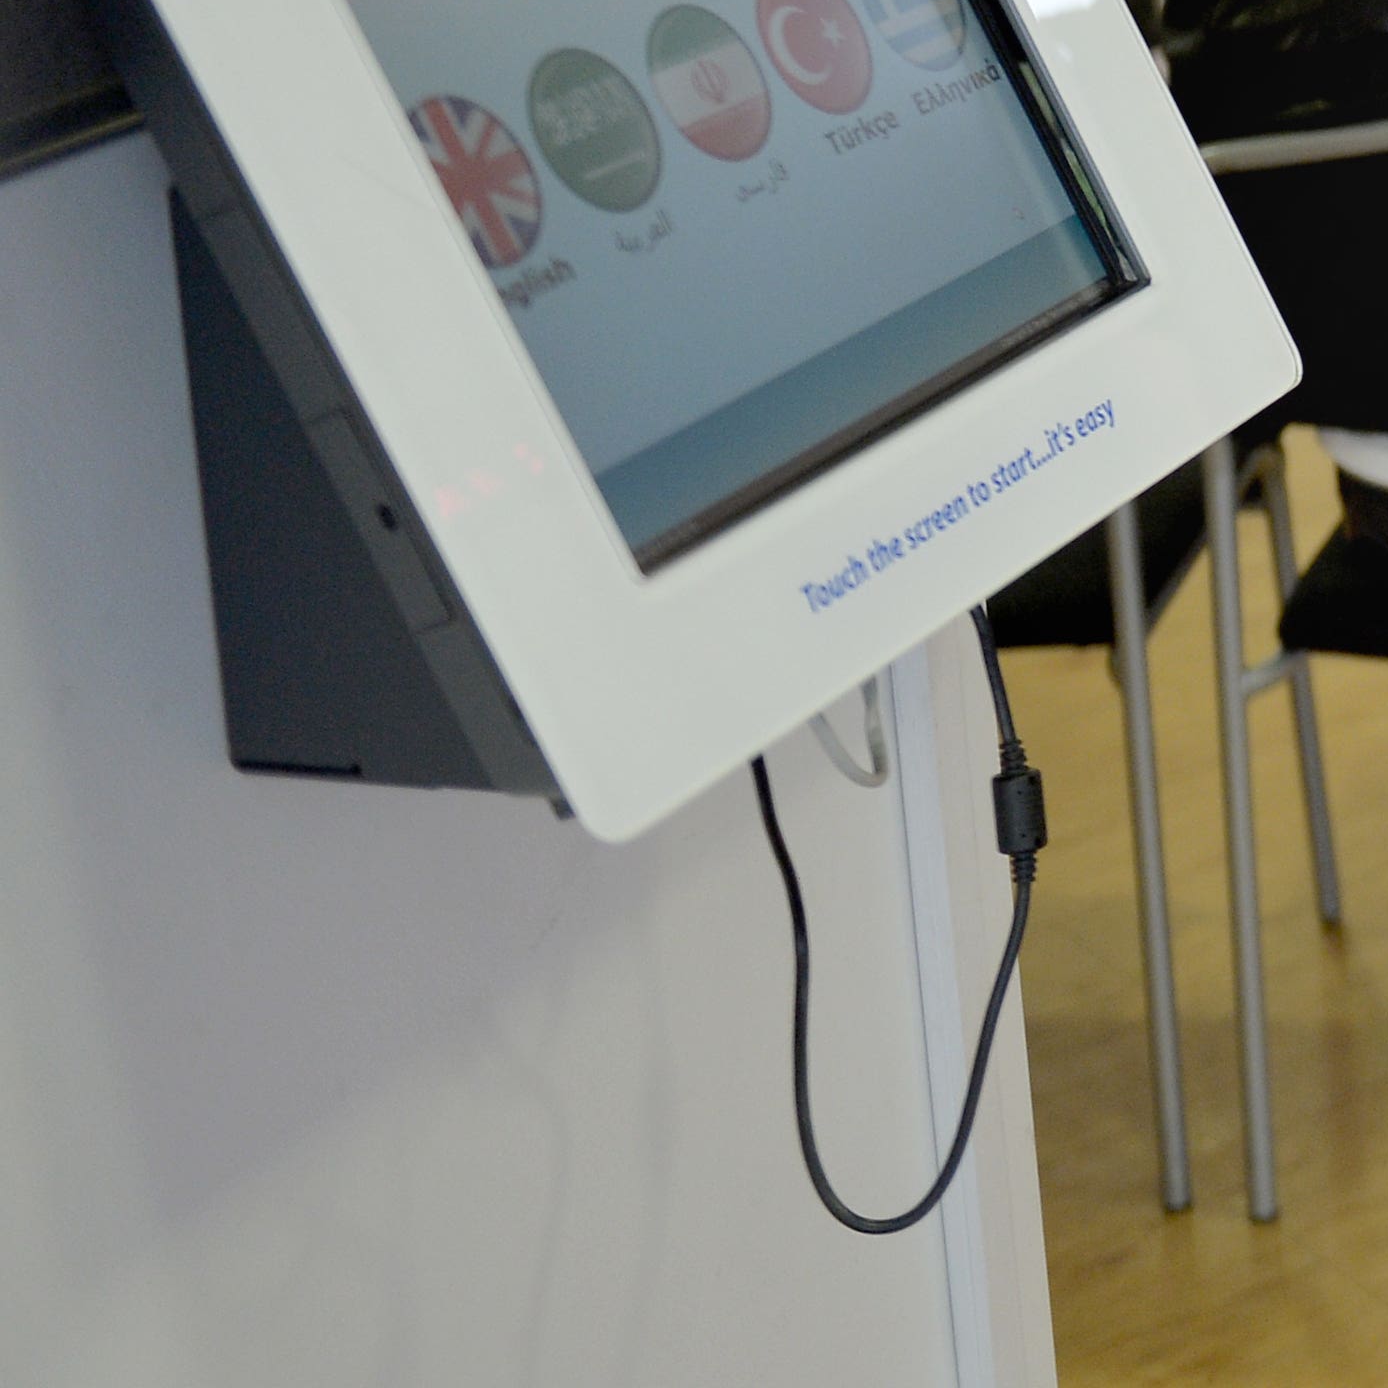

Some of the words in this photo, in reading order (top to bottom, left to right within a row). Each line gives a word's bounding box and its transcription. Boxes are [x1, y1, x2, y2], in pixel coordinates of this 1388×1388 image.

[822, 108, 901, 157] Türkçe
[497, 255, 578, 308] nglish
[801, 555, 870, 613] Touch
[866, 538, 905, 573] the
[903, 494, 970, 549] screen
[965, 480, 991, 507] to
[1075, 398, 1116, 439] easy
